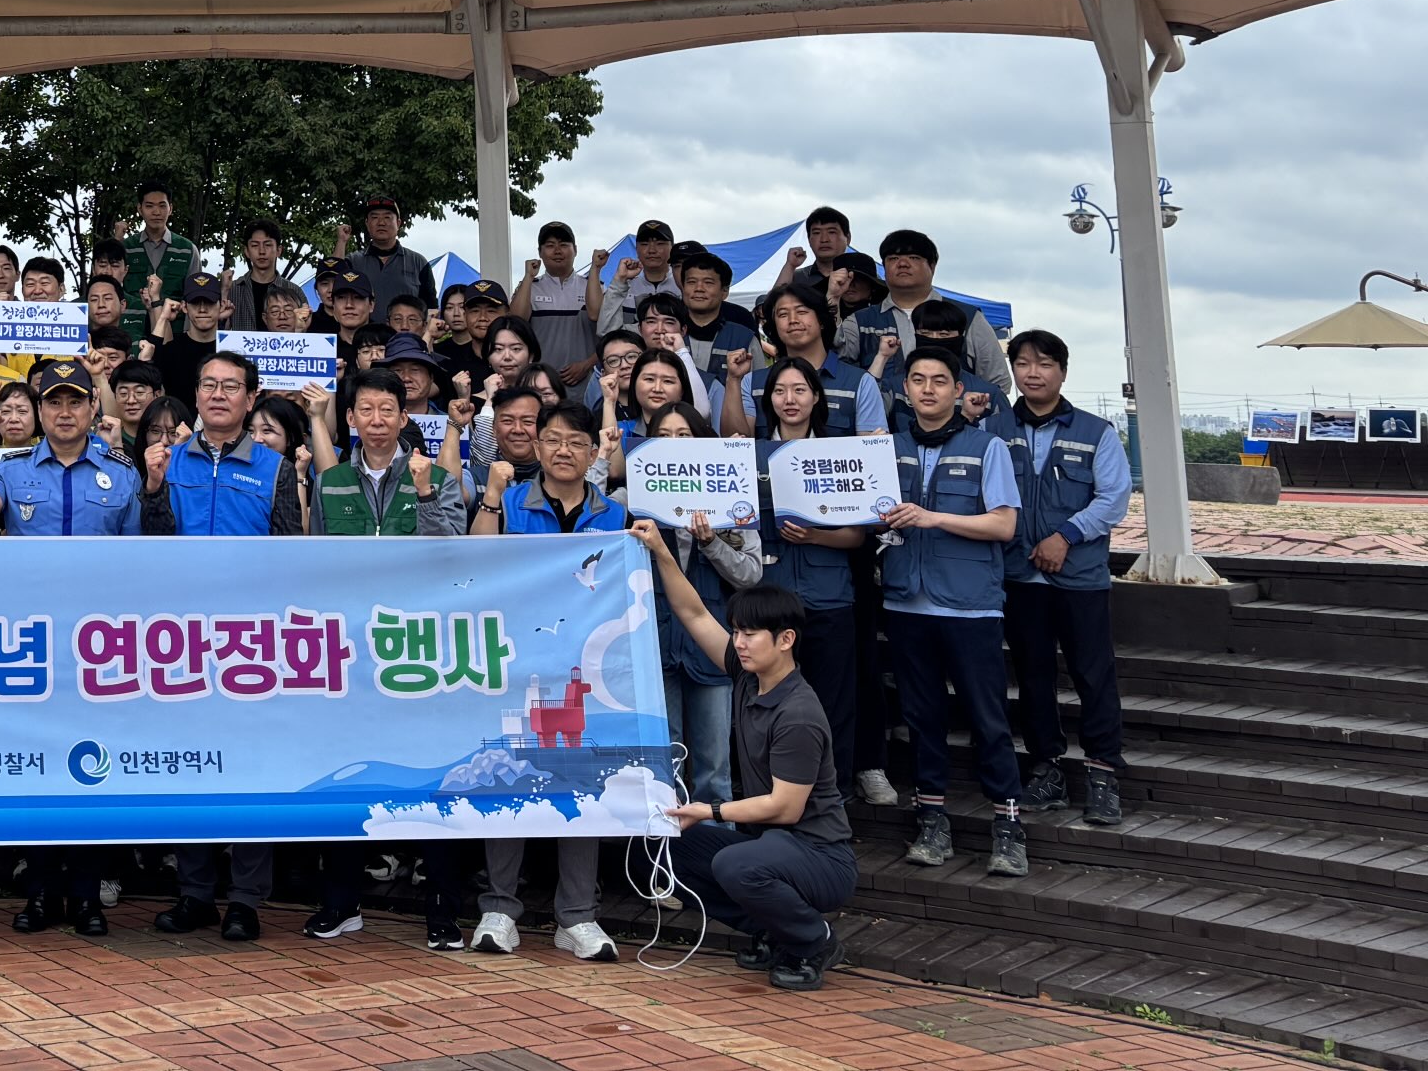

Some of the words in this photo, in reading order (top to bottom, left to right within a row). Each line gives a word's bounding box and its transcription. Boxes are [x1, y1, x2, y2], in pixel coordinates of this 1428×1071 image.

[15, 325, 79, 338] 앞장서겠습니다
[257, 357, 327, 373] 앞장서겠습니다
[644, 463, 700, 476] CLEAN
[705, 463, 738, 477] SEA
[801, 459, 863, 475] 청렴해야
[645, 479, 701, 492] GREEN
[706, 479, 739, 493] SEA
[803, 478, 865, 494] 깨끗해요
[78, 612, 351, 696] 연안정화
[372, 611, 510, 692] 행사
[119, 751, 223, 775] 인천광역시
